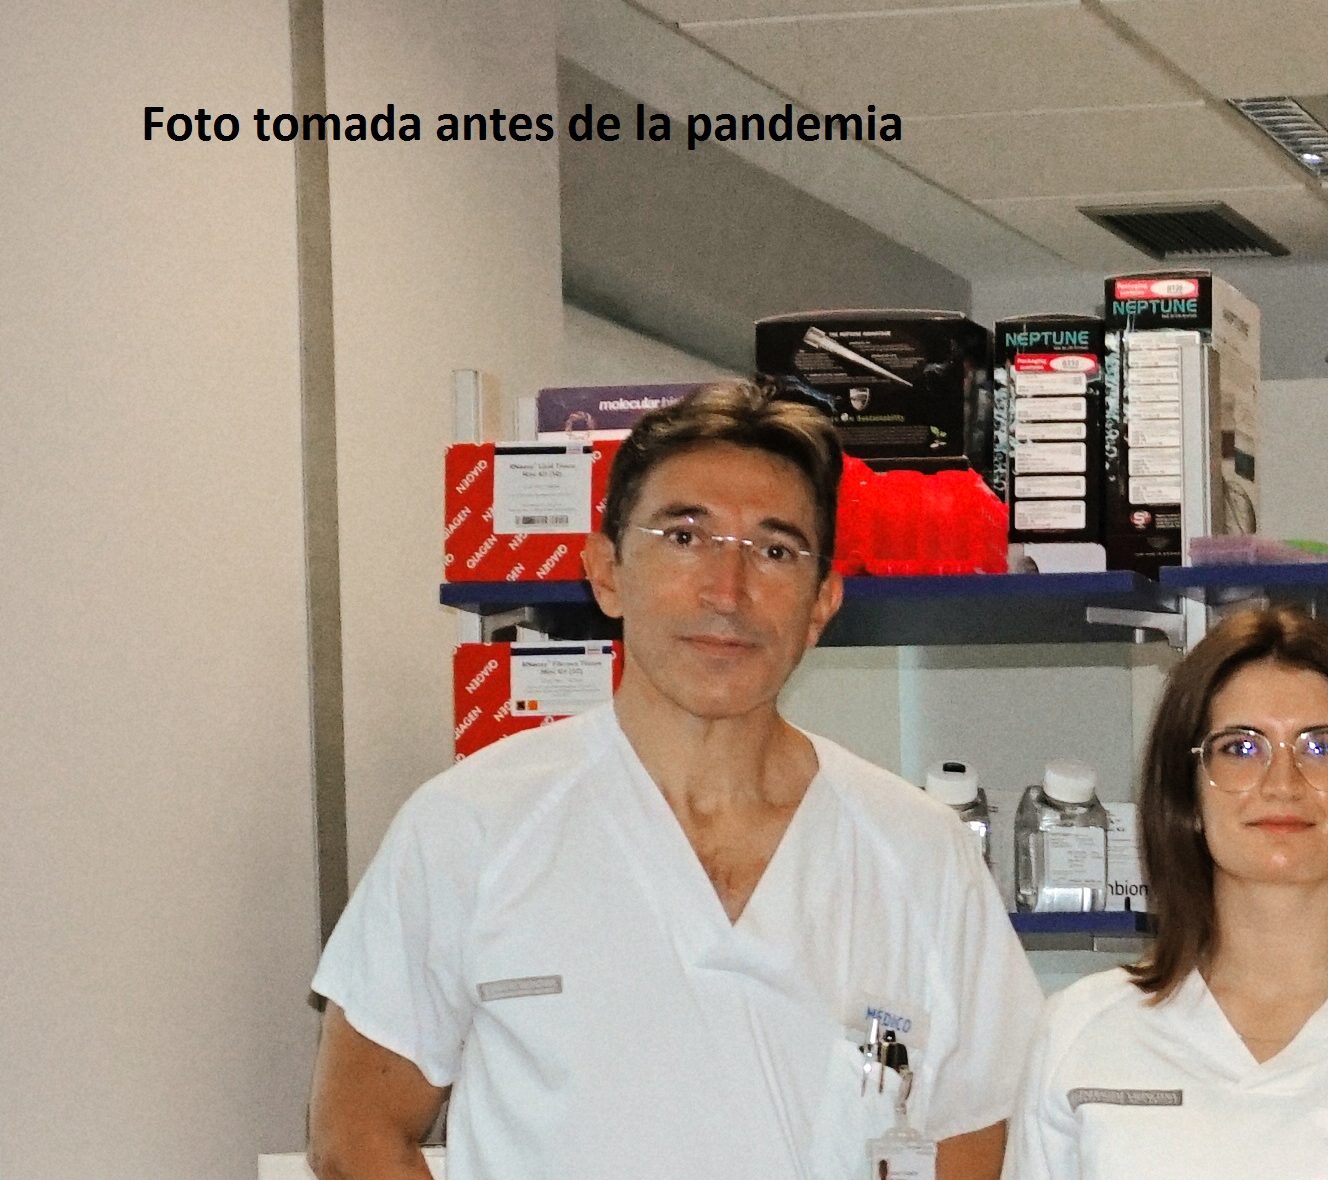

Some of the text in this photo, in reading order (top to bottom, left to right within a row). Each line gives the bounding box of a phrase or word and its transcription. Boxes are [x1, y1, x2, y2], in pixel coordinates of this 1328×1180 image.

[1112, 298, 1198, 316] NEPTUNE
[1005, 330, 1089, 348] NEPTUNE
[456, 459, 488, 494] QIAGEN
[445, 505, 472, 540] IAGEN
[466, 533, 498, 569] QIAGEN
[535, 543, 568, 580] QIAGEN
[464, 658, 499, 694] QIAGEN
[1107, 880, 1149, 896] bion
